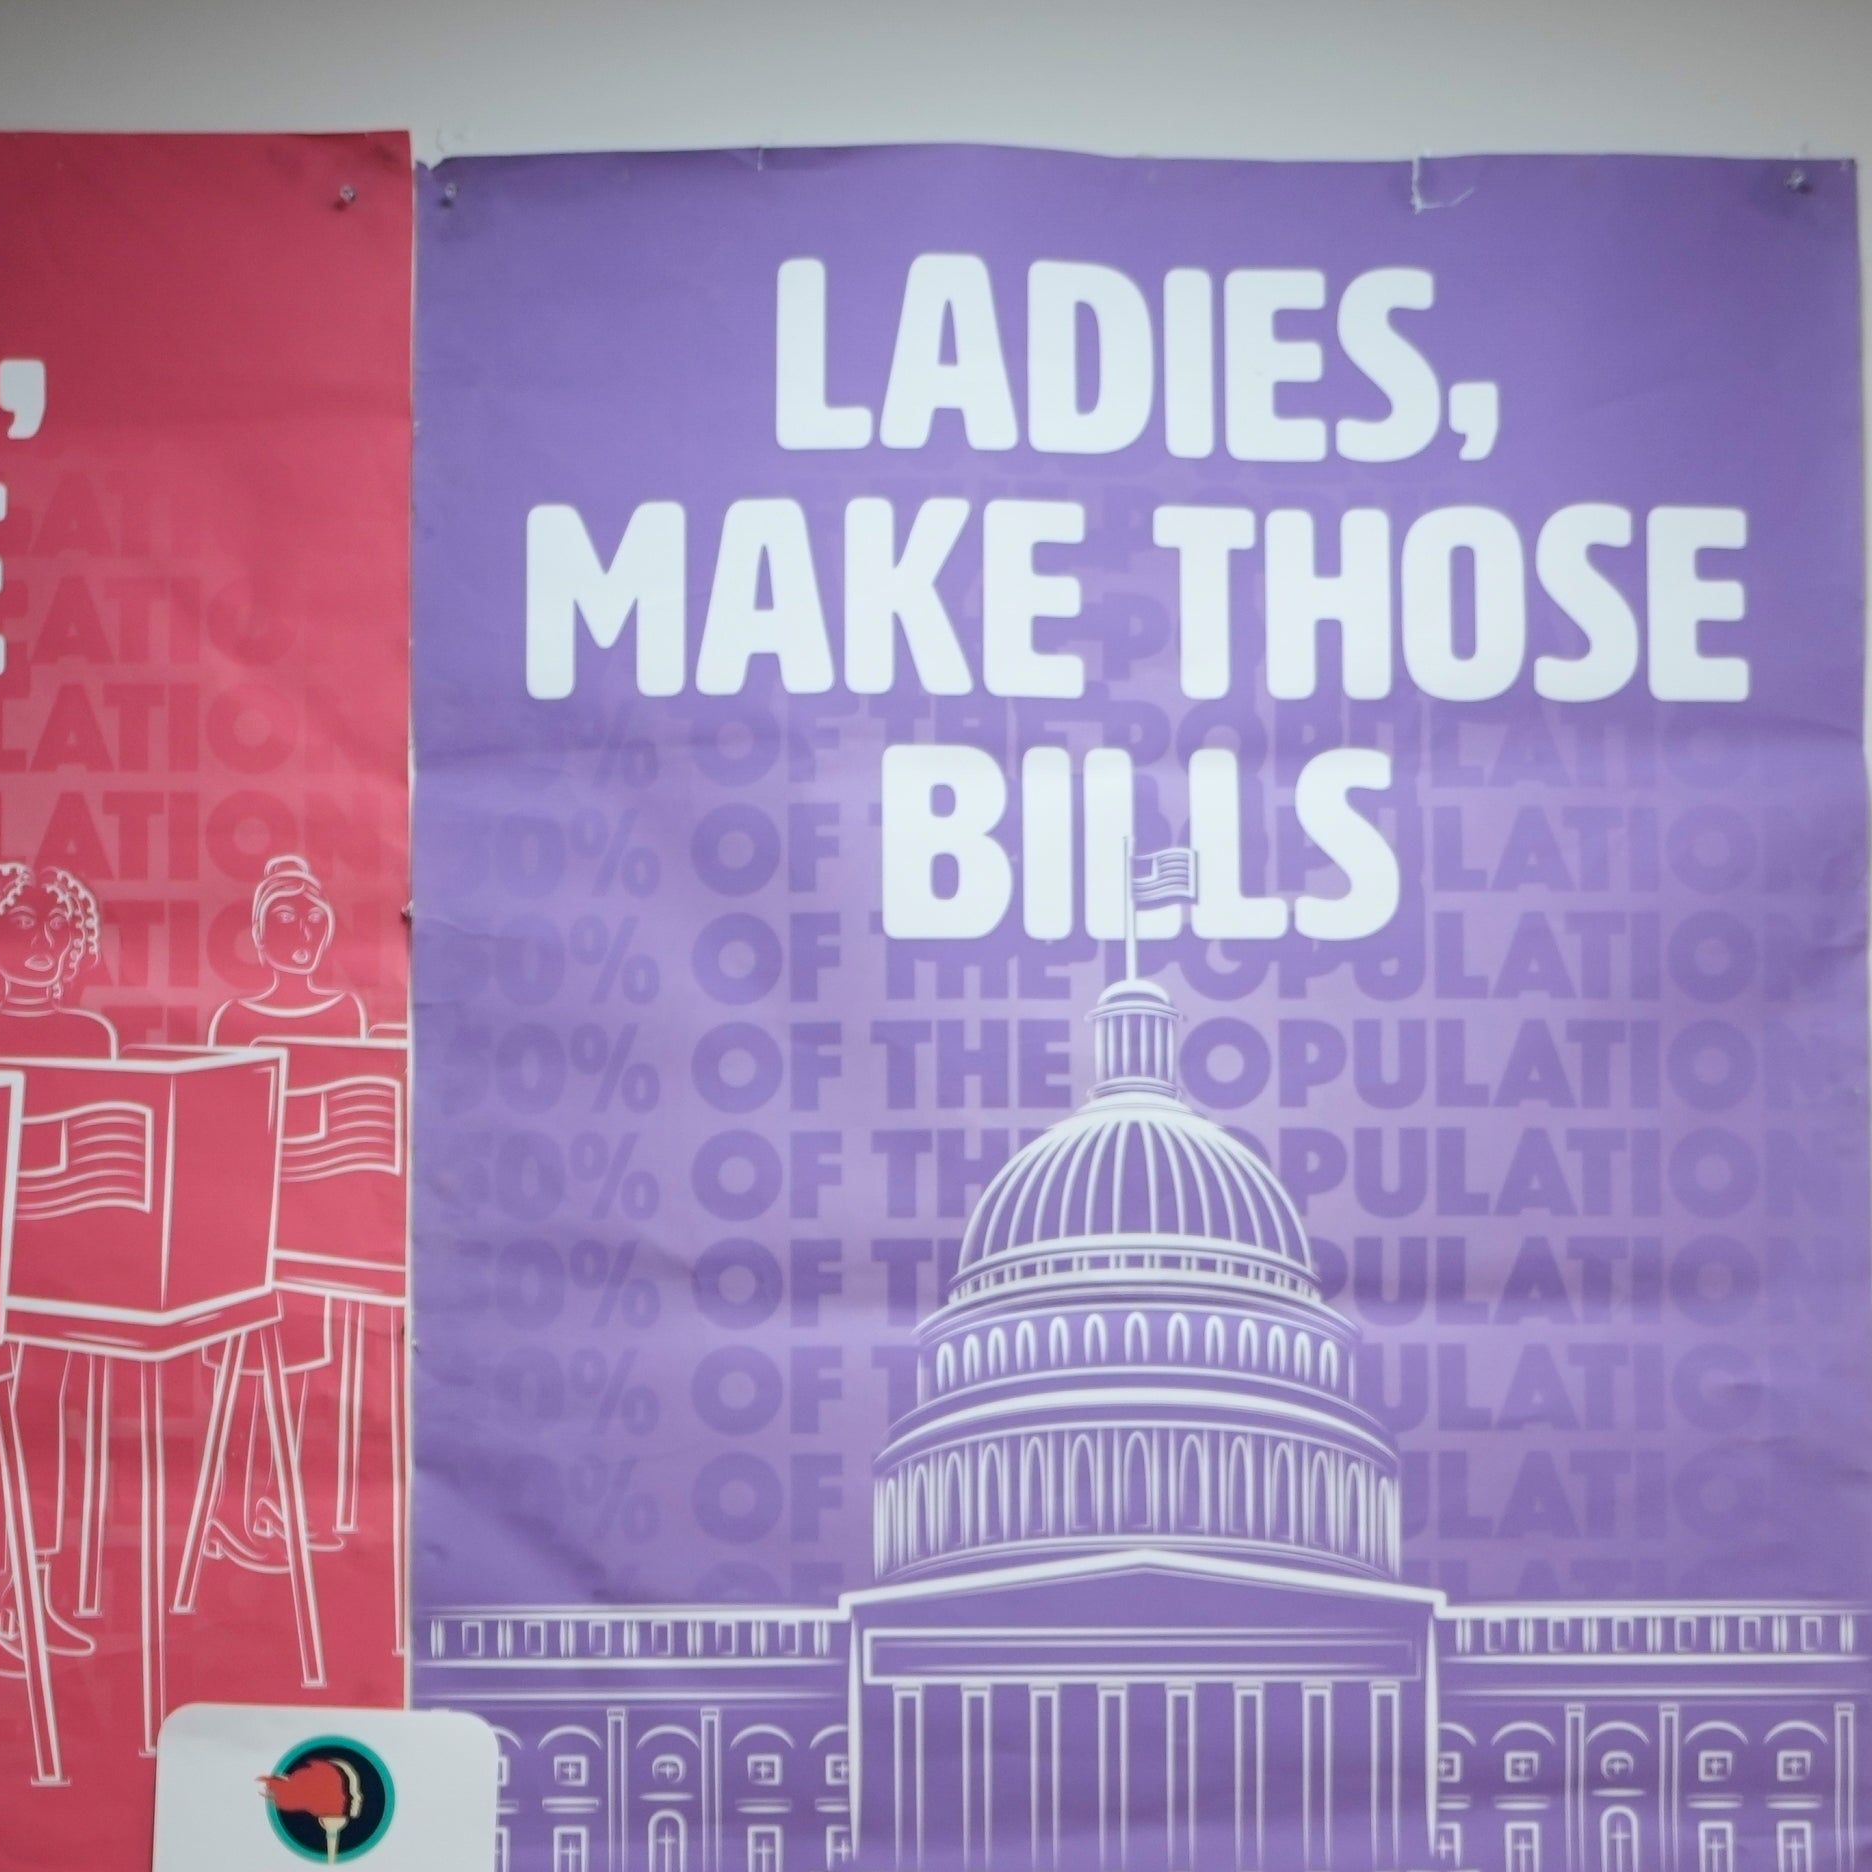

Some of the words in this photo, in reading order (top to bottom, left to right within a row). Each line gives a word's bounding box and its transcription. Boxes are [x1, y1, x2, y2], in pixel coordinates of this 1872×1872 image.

[775, 253, 1501, 463] LADIES,
[525, 498, 1086, 701] MAKE
[1151, 501, 1752, 703] THOSE
[690, 804, 841, 897] OF
[881, 742, 1403, 941] BILLS
[691, 912, 843, 1005] OF
[691, 1021, 843, 1115] OF
[871, 1020, 1073, 1111] THE
[691, 1129, 843, 1223] OF
[691, 1238, 843, 1331] OF
[691, 1346, 843, 1437] OF
[691, 1453, 843, 1545] OF
